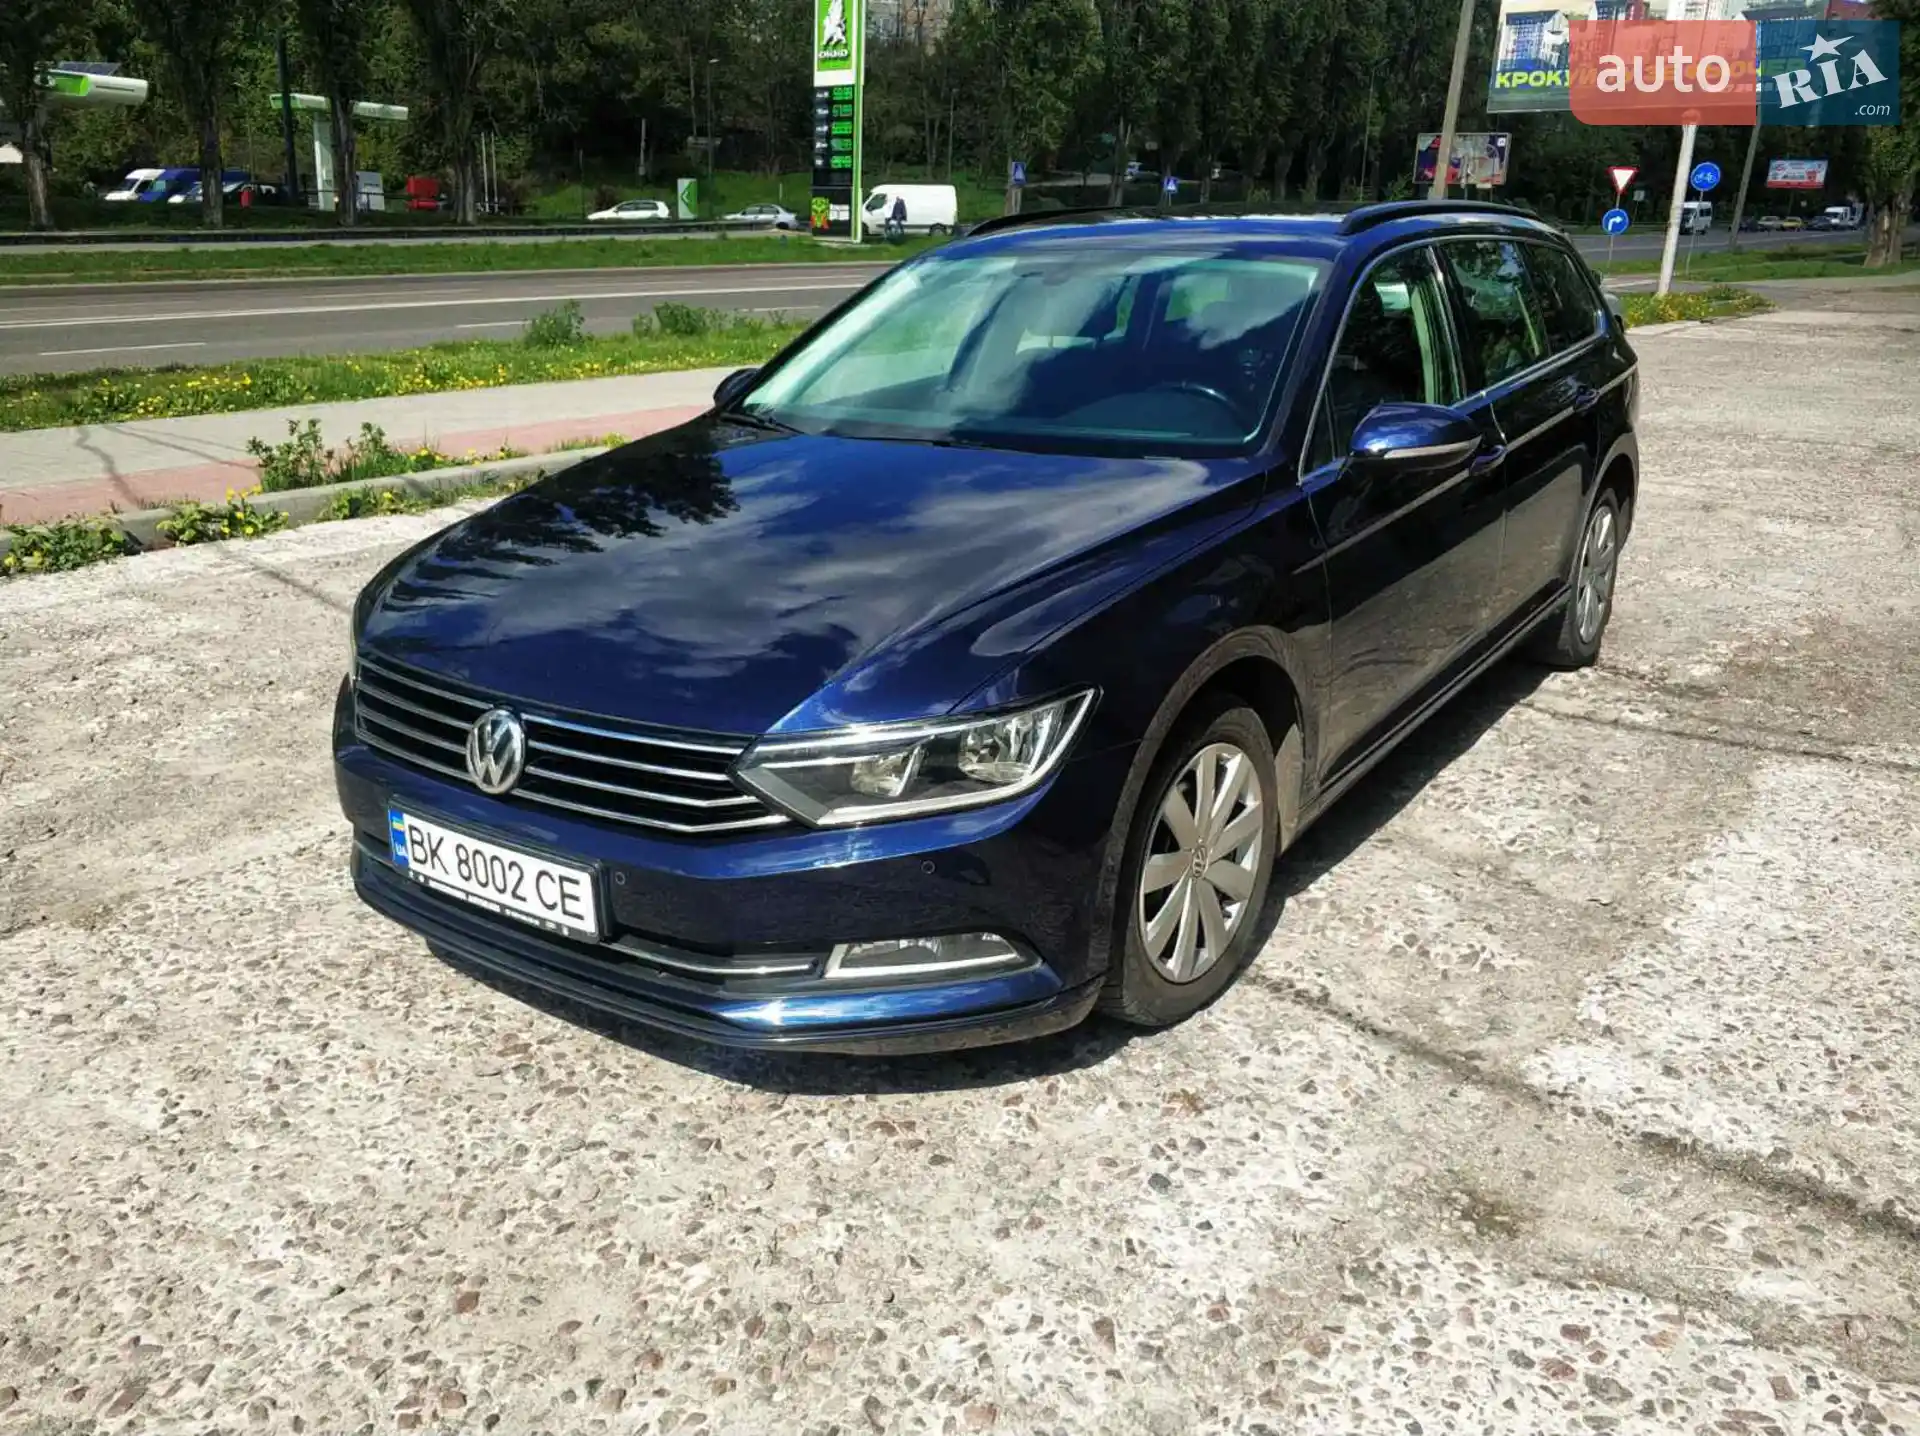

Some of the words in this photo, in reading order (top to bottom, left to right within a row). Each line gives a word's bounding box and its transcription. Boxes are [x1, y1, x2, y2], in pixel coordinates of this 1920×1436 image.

[407, 824, 449, 876] BK
[454, 843, 528, 903] 8002
[535, 869, 585, 921] CE
